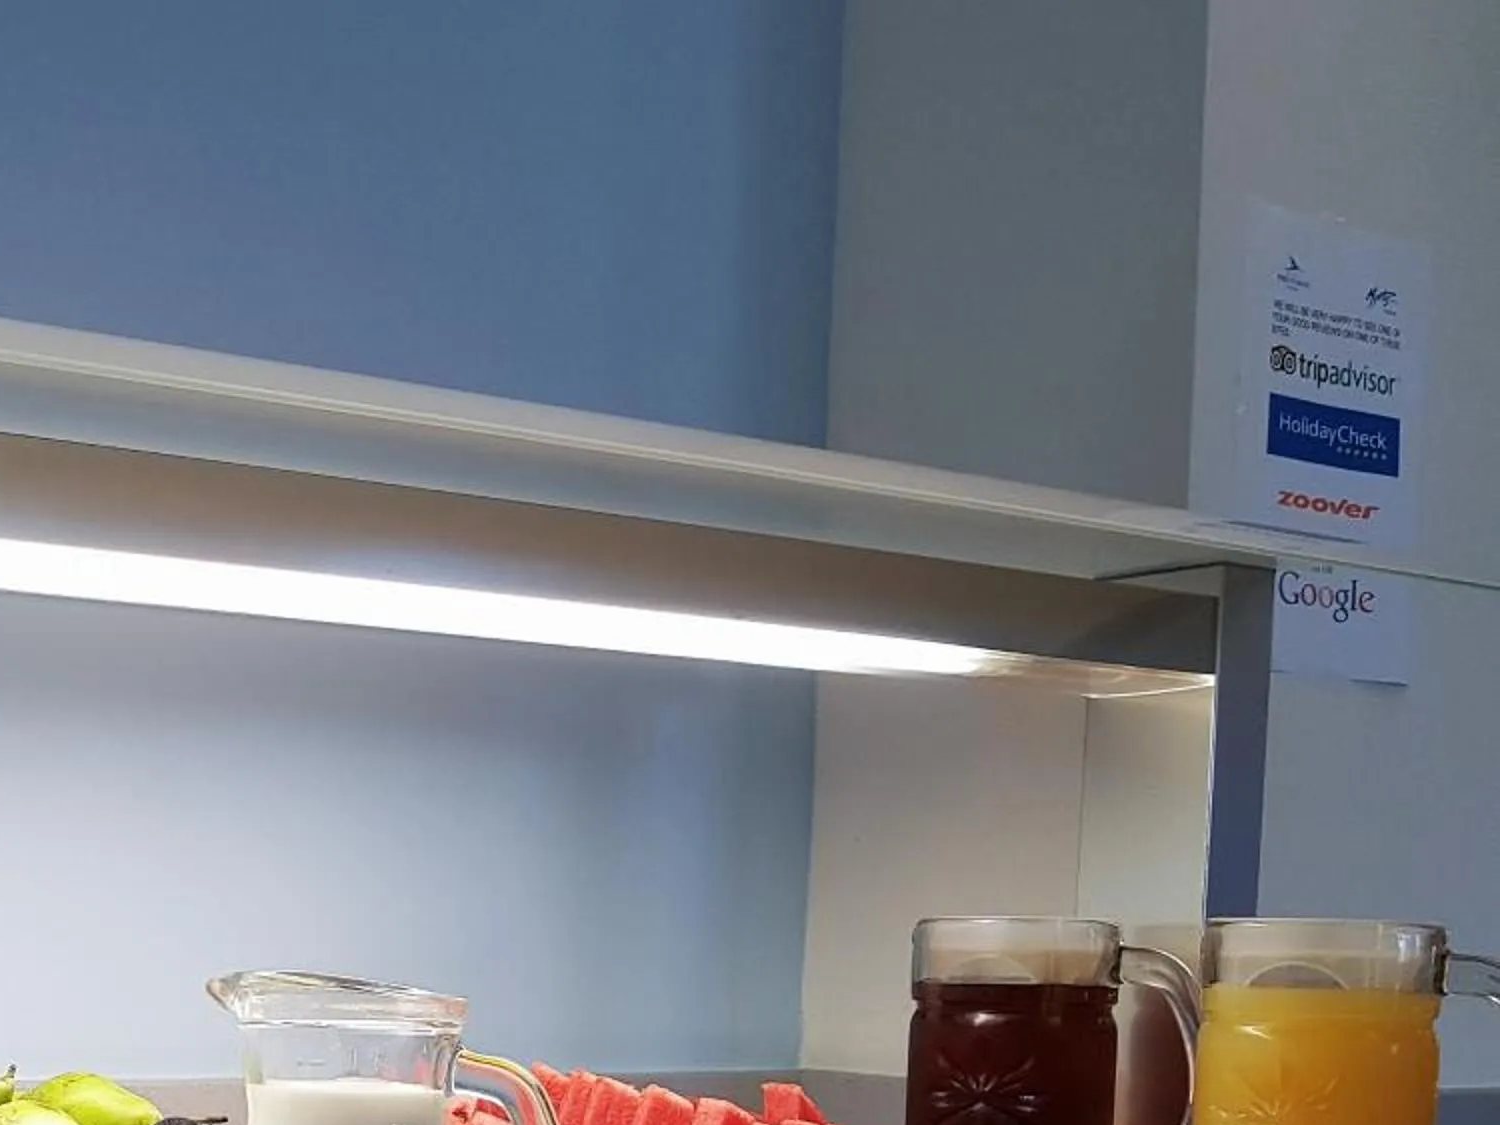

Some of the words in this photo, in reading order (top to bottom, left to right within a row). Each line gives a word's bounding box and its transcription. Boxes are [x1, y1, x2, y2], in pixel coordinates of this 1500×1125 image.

[1299, 353, 1397, 396] tripadvisor
[1279, 411, 1388, 450] HolidayCheck
[1277, 490, 1381, 520] zoover
[1278, 570, 1377, 623] Google
